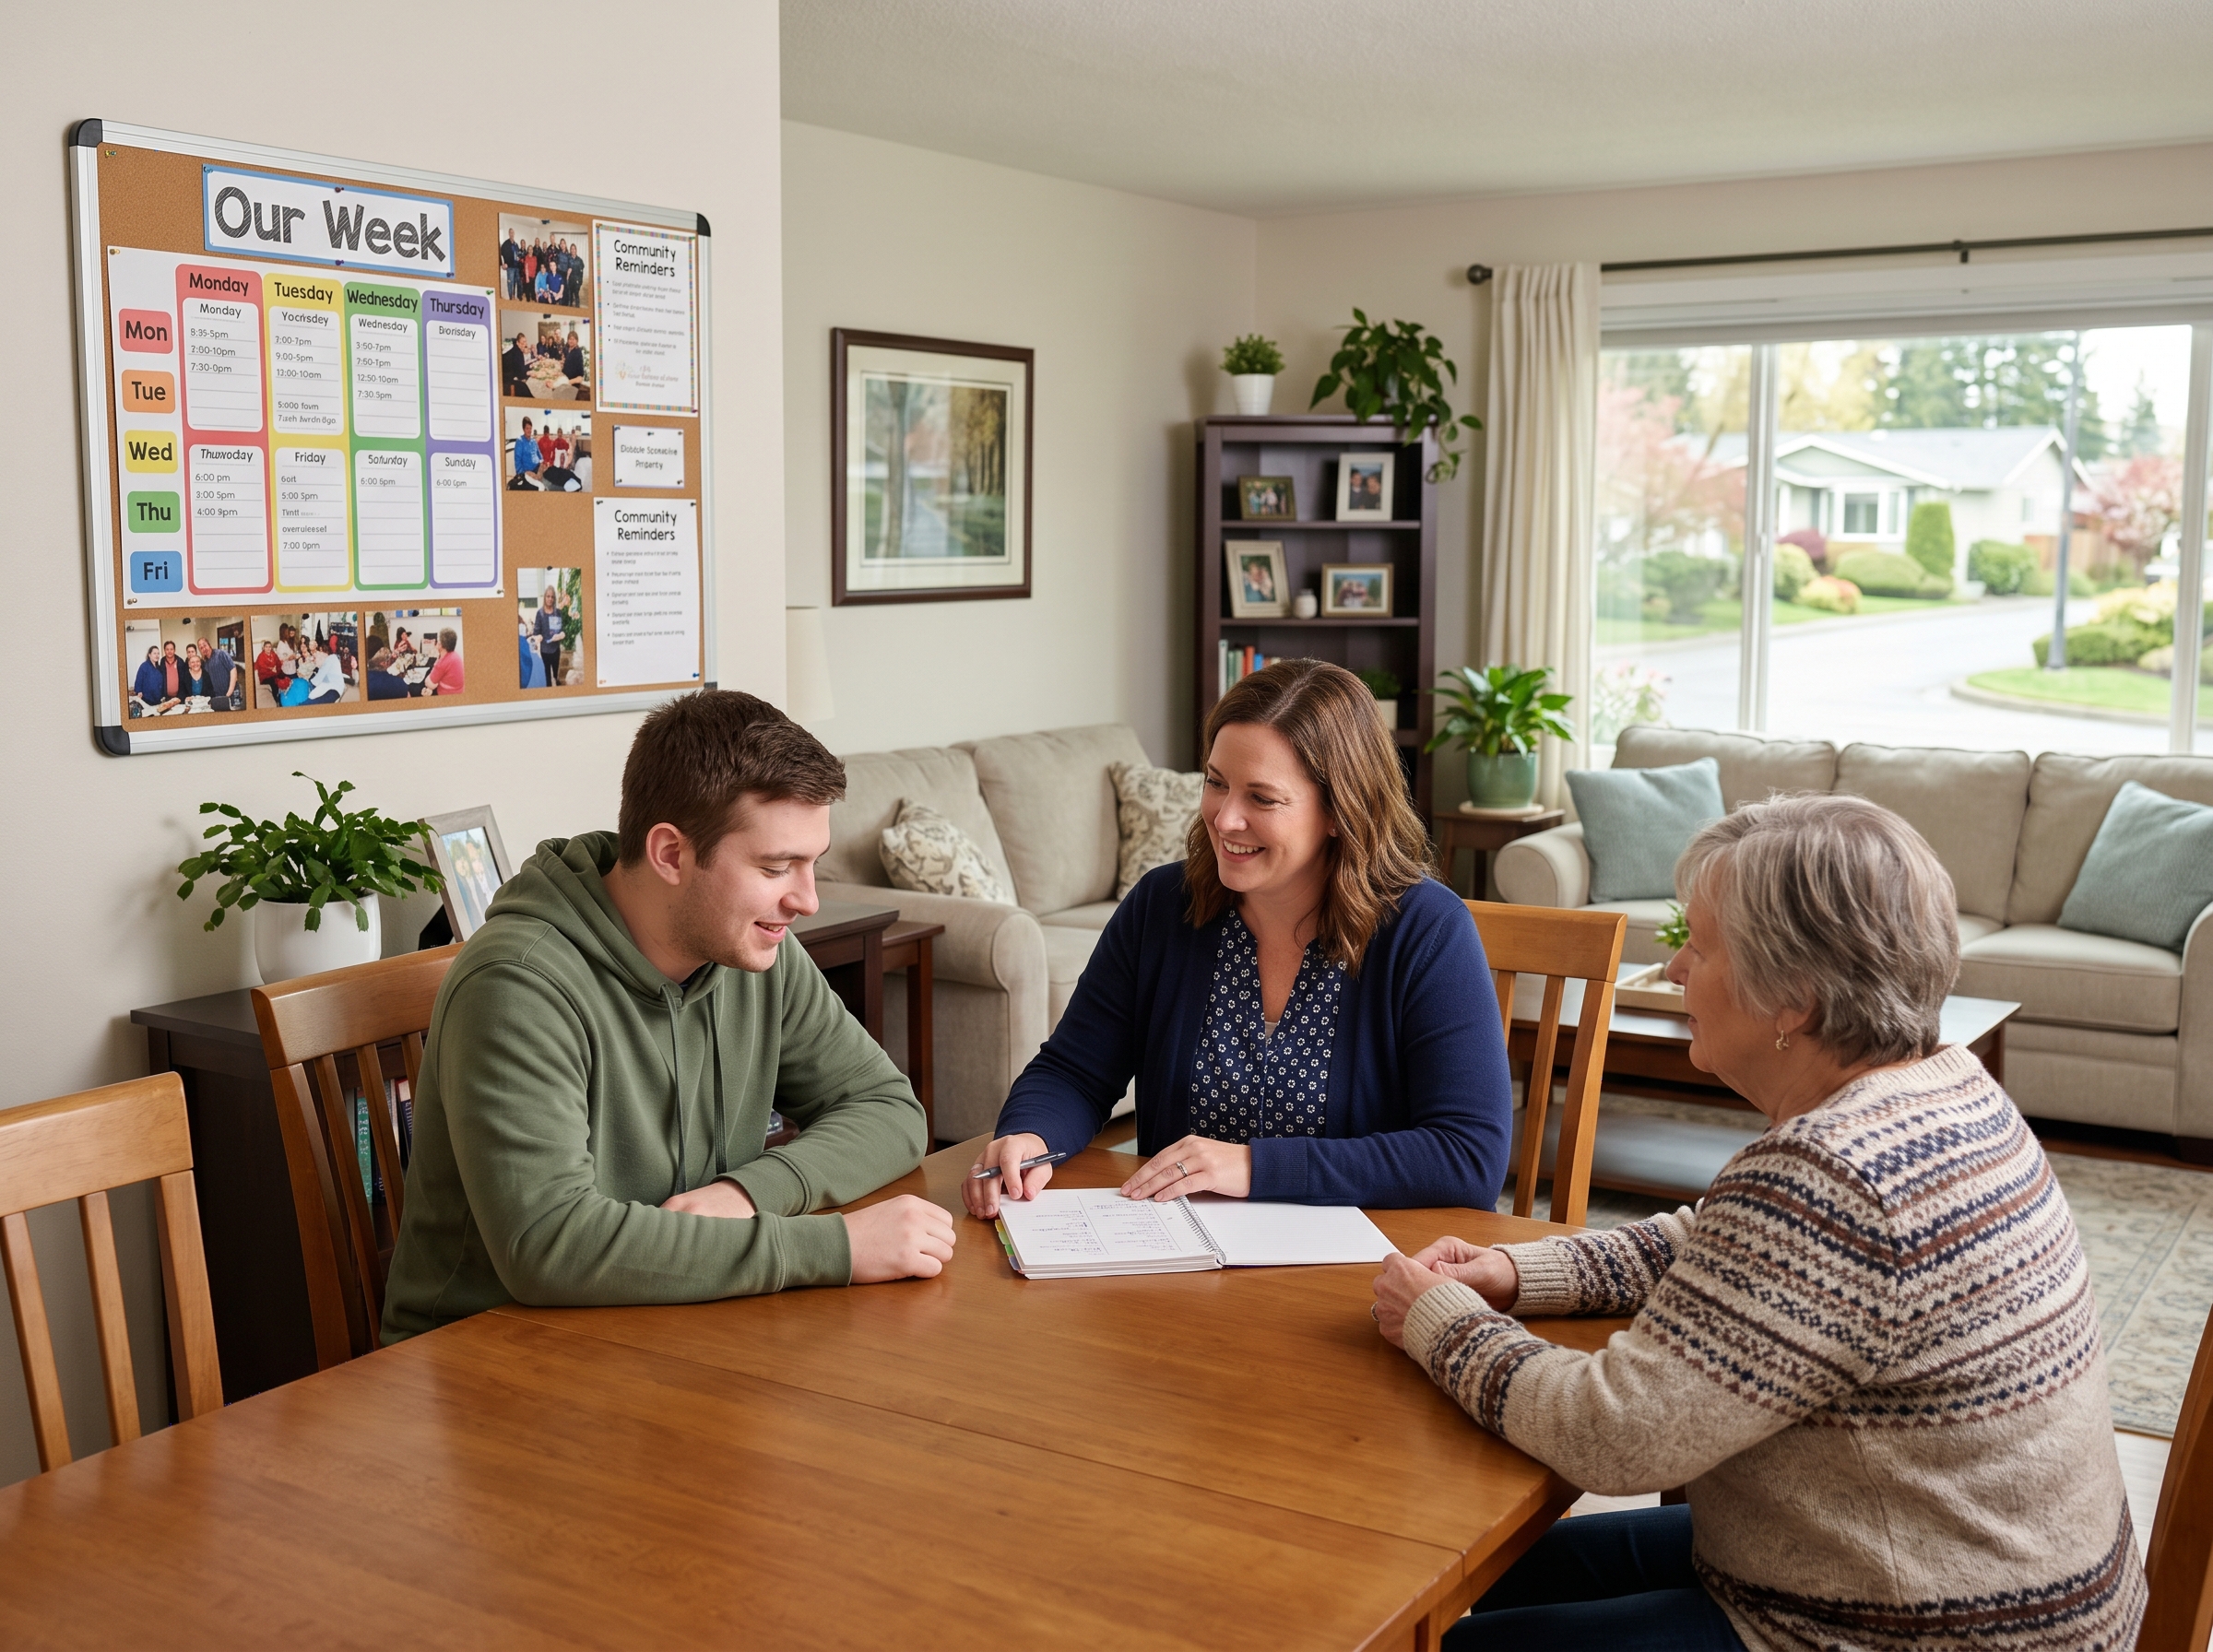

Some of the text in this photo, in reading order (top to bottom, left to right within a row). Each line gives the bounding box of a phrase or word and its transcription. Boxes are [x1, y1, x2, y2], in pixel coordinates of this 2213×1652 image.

[214, 186, 446, 263] Our Week
[614, 240, 676, 263] Community
[616, 257, 675, 277] Reminders
[189, 272, 249, 297] Monday
[274, 282, 333, 304] Tuesday
[199, 303, 242, 319] Monday
[347, 289, 418, 313] Wednesday
[430, 298, 484, 319] Thursday
[125, 320, 167, 341] Mon
[359, 318, 408, 333] Wednesday
[131, 381, 166, 401] Tue
[128, 441, 172, 461] Wed
[294, 452, 326, 465] Friday
[195, 473, 231, 483] 6:00 pm
[195, 490, 215, 499] 3:00
[136, 502, 172, 521] Thu
[196, 508, 216, 516] 4:00
[614, 509, 677, 526] Community
[618, 527, 675, 540] Reminders
[143, 560, 169, 581] Fri
